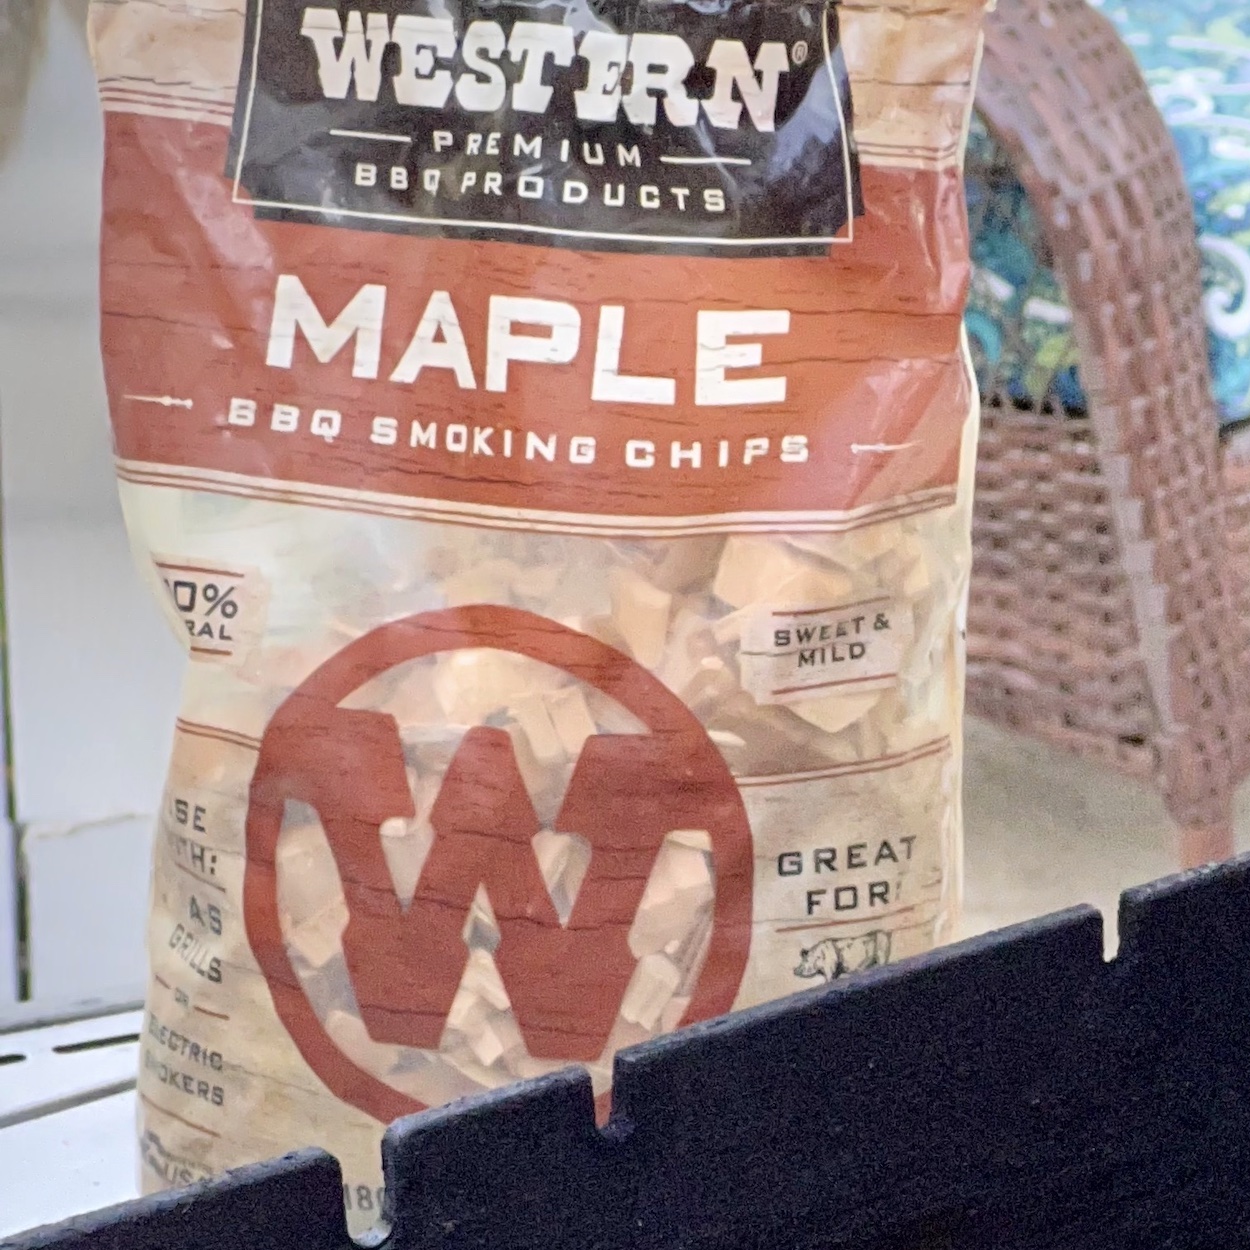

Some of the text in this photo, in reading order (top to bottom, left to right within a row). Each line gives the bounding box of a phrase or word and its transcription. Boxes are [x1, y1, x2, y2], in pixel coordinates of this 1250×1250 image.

[433, 130, 642, 168] PREMIUM
[355, 162, 726, 213] BBQ PRODUCTS
[265, 273, 791, 406] MAPLE
[227, 397, 810, 469] BBQ SMOKING CHIPS
[164, 578, 239, 619] 0%
[774, 613, 893, 648] SWEET &
[798, 642, 867, 668] MILD
[777, 835, 918, 877] GREAT
